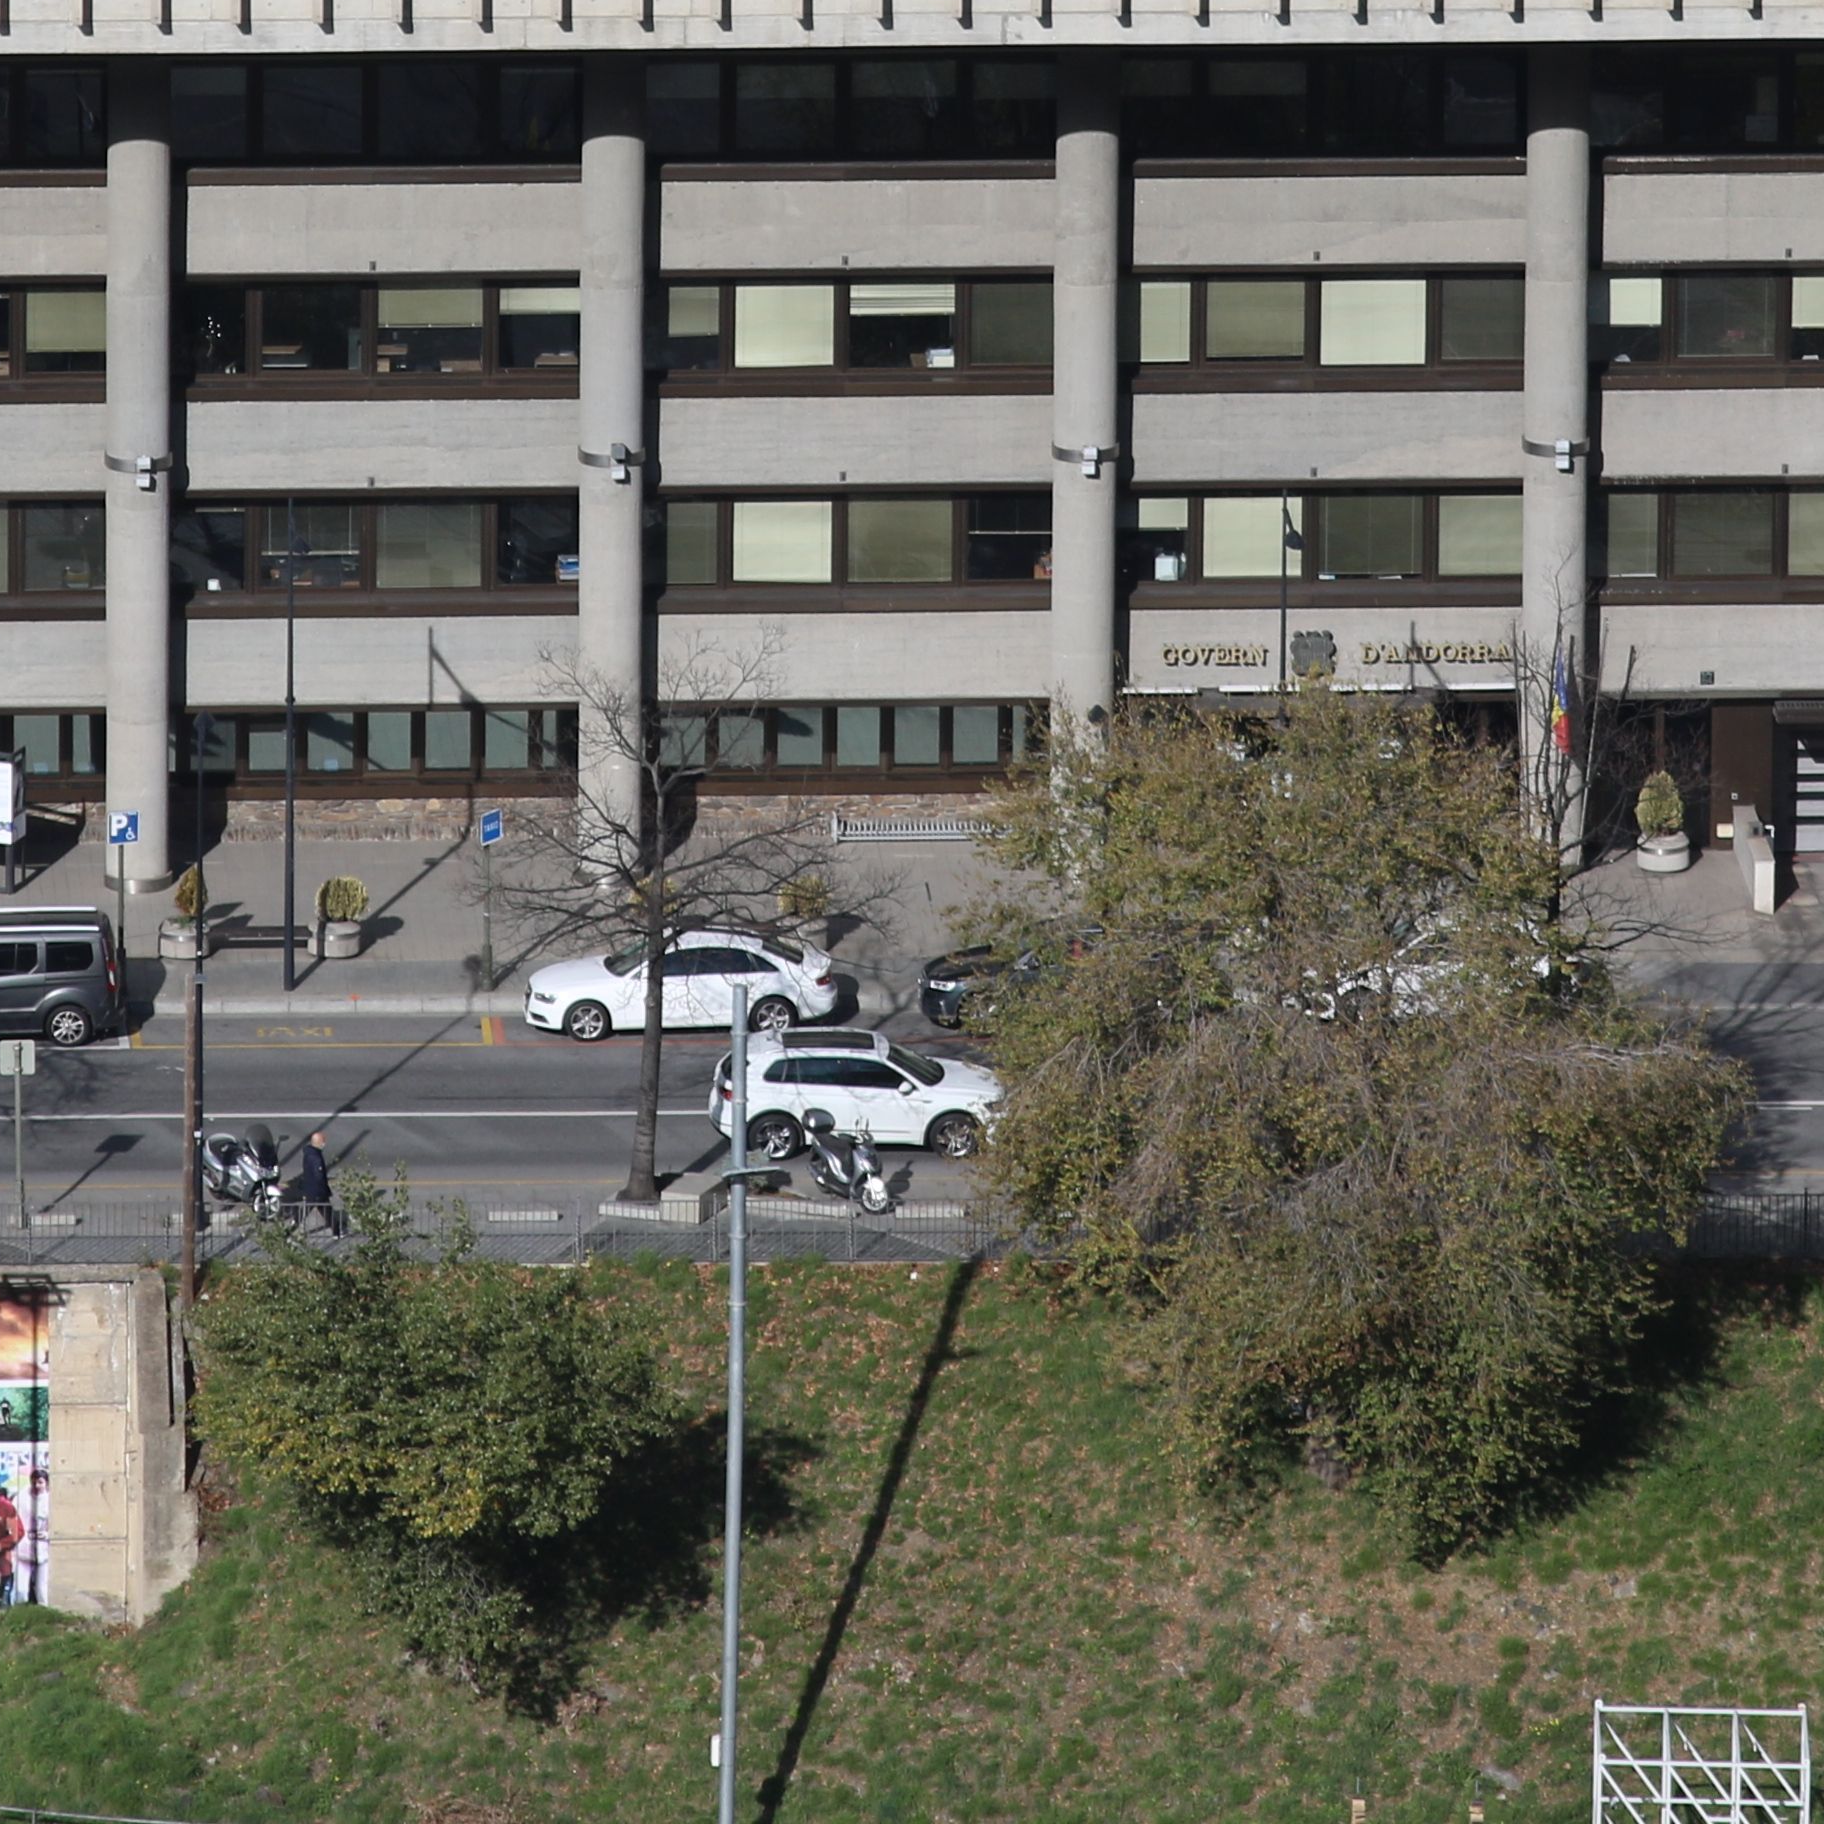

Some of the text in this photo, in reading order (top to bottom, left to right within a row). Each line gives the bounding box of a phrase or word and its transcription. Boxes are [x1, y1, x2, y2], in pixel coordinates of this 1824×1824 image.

[1161, 640, 1517, 667] GOVERN D'ANDORRA
[111, 813, 128, 837] P
[256, 1025, 333, 1038] TAXI
